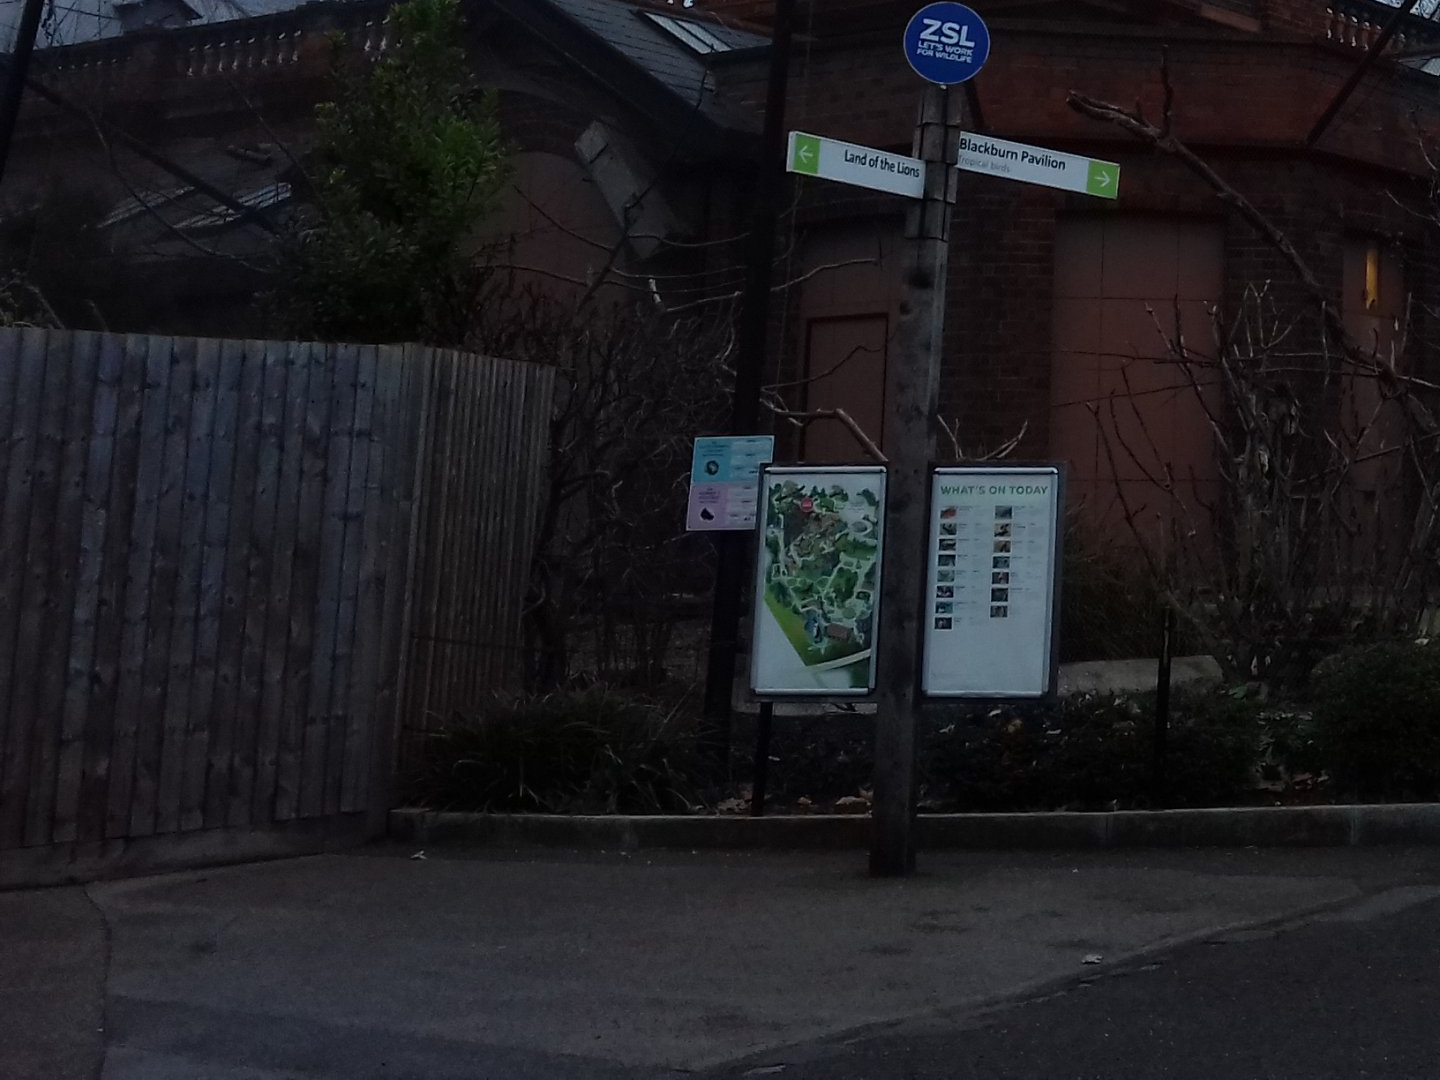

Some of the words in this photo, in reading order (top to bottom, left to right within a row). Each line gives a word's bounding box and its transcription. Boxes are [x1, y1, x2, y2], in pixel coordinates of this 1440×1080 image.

[919, 18, 976, 48] ZSL
[916, 48, 934, 57] FOR
[935, 51, 973, 64] WILDLIFE
[918, 40, 944, 51] LET'S
[945, 44, 974, 56] WORK
[959, 137, 1018, 161] Blackburn
[1020, 151, 1066, 171] Pavilion
[844, 149, 868, 166] Land
[868, 155, 879, 168] of
[880, 158, 895, 173] the
[897, 162, 920, 178] Lions
[990, 162, 1011, 174] birds
[940, 485, 986, 496] WHAT'S
[988, 485, 1006, 495] ON
[1009, 485, 1049, 496] TODAY
